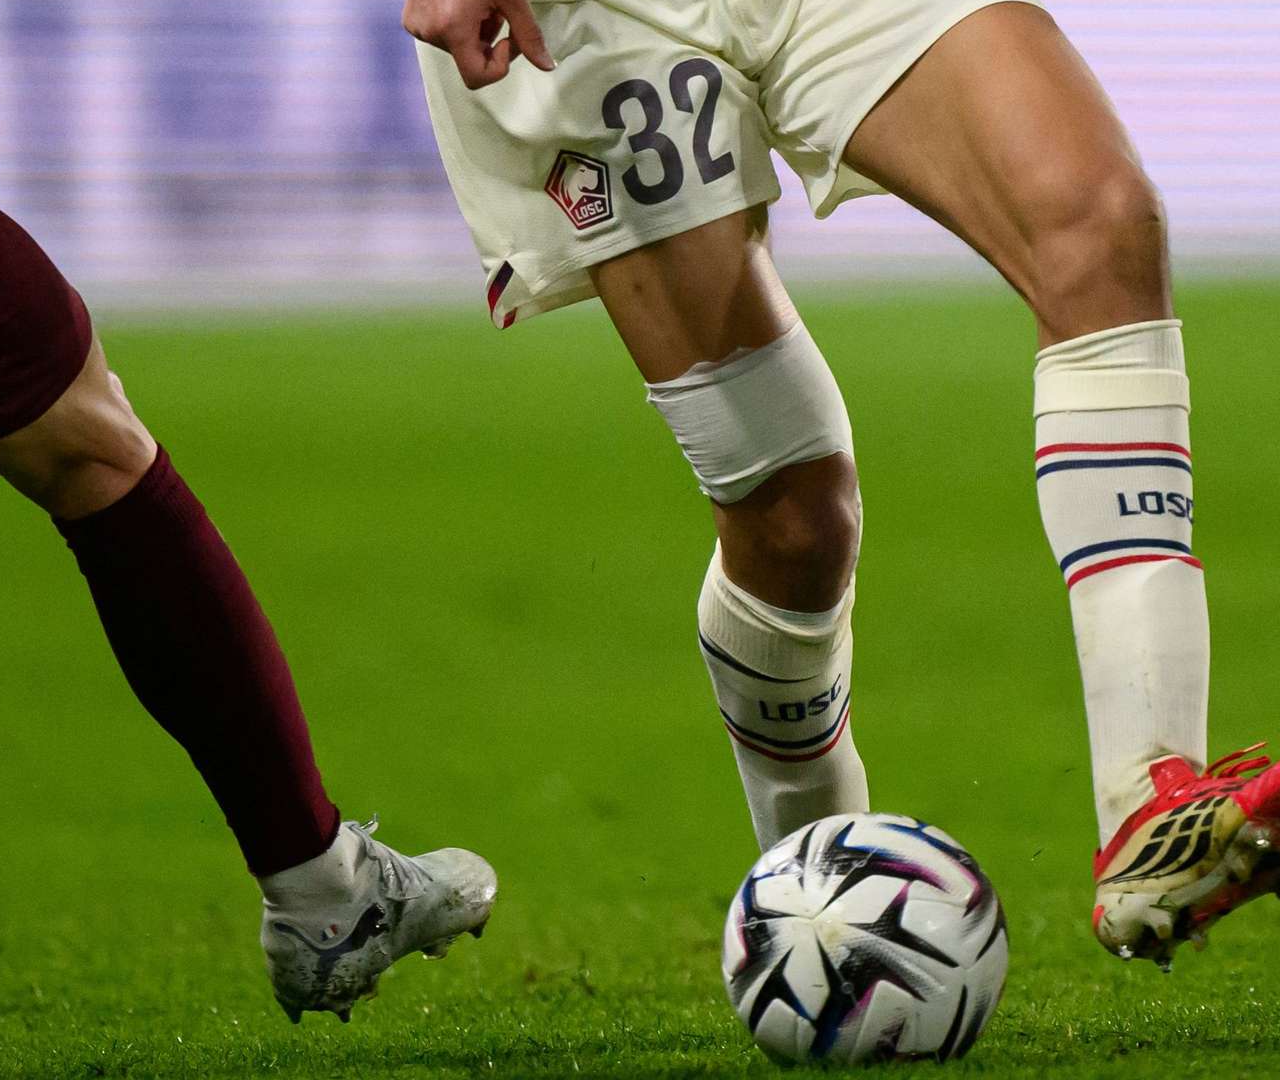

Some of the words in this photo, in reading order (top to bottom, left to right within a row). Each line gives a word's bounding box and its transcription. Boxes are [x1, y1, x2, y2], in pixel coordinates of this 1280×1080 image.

[601, 57, 736, 206] 32
[574, 199, 605, 221] LOSC
[759, 673, 841, 722] LOSC
